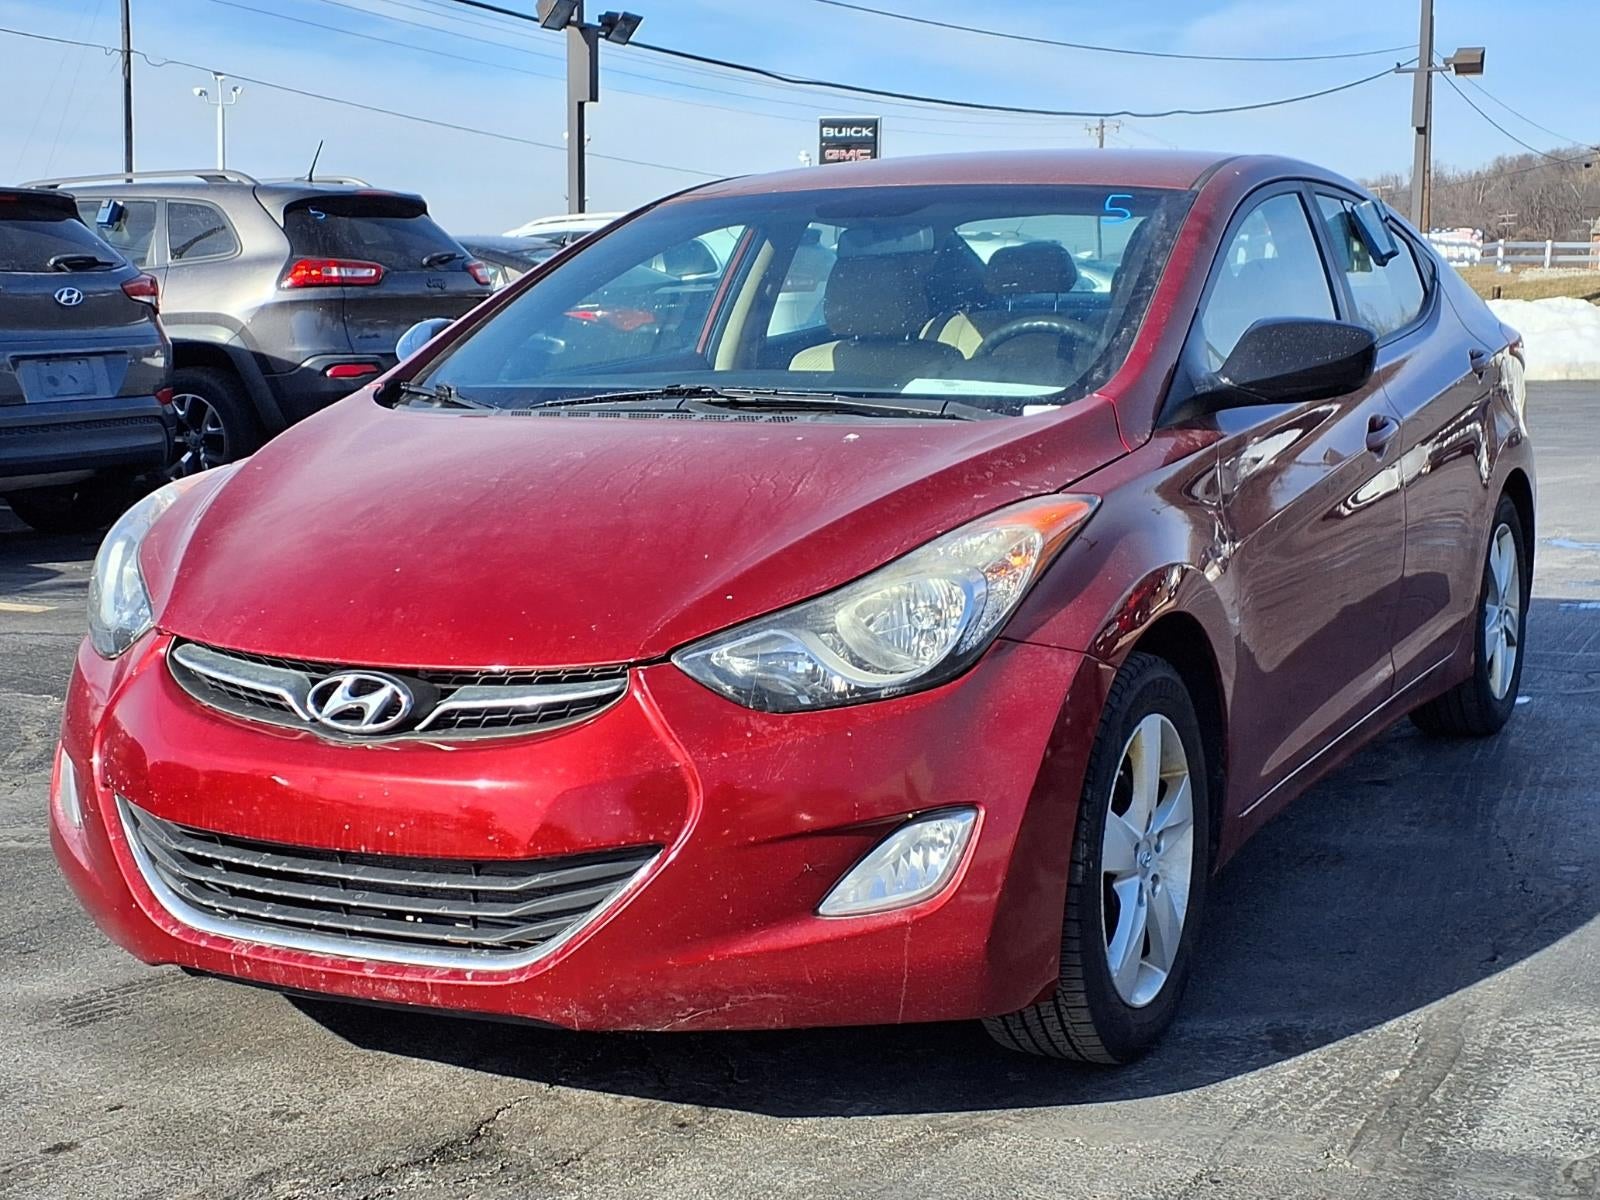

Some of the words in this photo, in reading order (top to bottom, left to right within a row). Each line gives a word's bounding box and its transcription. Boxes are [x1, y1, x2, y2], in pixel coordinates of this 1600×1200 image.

[822, 127, 874, 137] BUICK
[824, 149, 872, 161] GMC
[1101, 194, 1133, 224] 5
